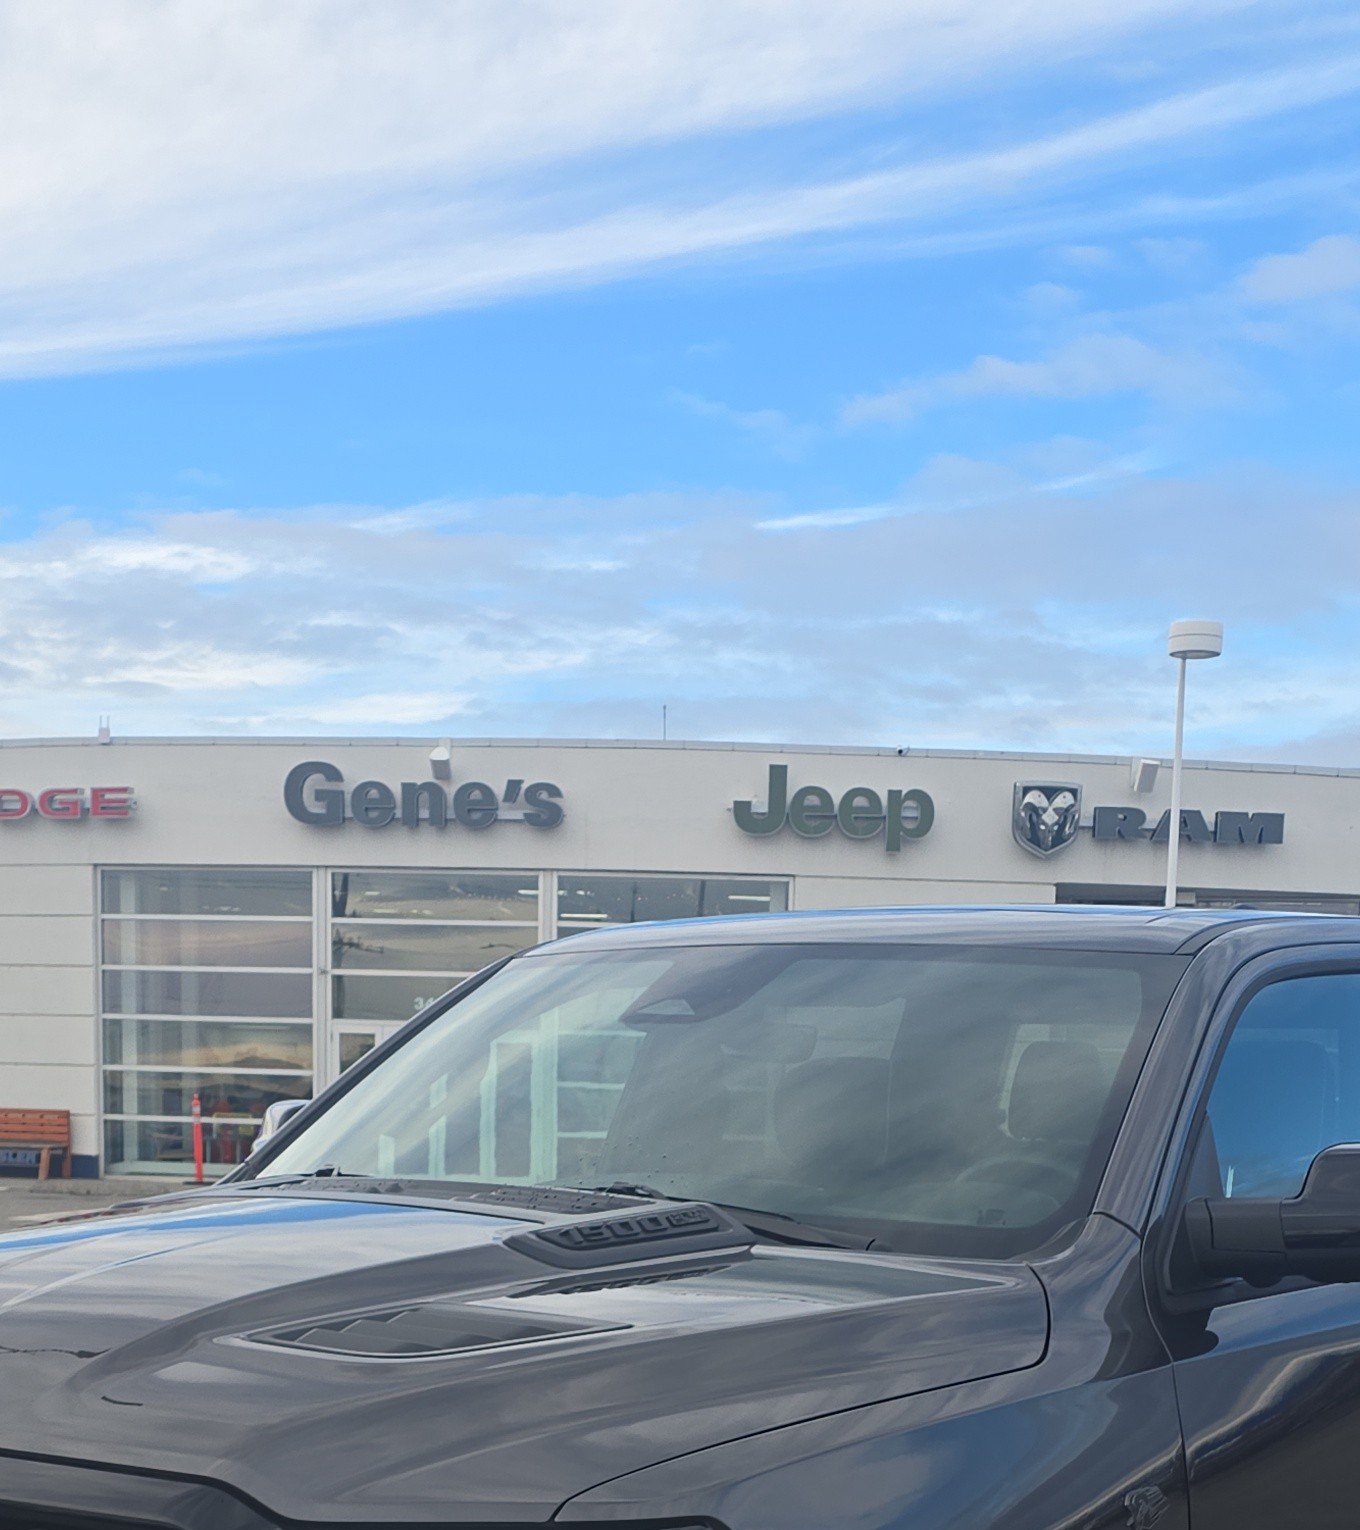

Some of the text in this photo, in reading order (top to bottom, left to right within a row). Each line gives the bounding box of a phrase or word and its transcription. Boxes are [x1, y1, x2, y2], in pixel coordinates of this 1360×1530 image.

[283, 761, 565, 829] Gene's
[732, 764, 936, 852] Jeep
[1092, 806, 1286, 845] RAM
